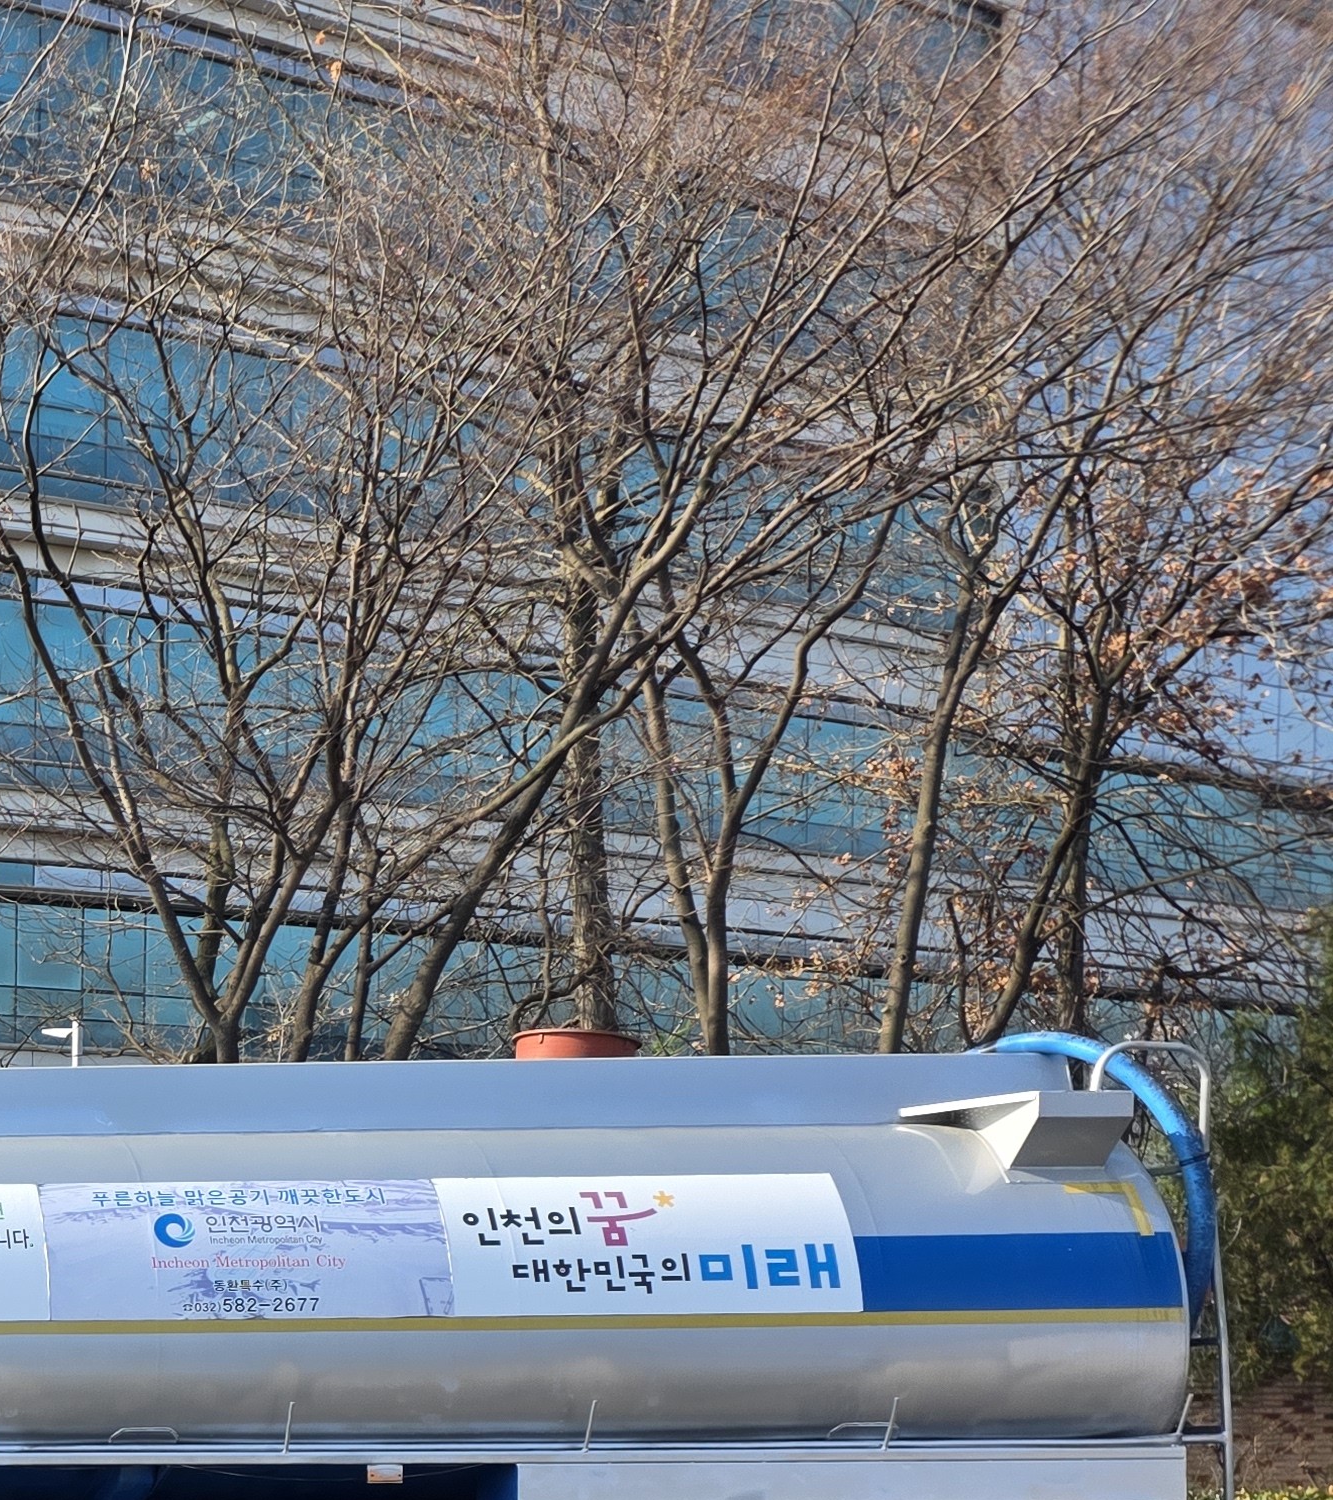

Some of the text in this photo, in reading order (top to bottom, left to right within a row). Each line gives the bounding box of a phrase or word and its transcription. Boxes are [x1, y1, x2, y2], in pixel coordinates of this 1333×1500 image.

[92, 1187, 386, 1207] 푸른하늘 맑은공기 깨끗한도시
[205, 1214, 321, 1233] 인천광역시
[462, 1191, 658, 1247] 인천의 꿈
[209, 1235, 323, 1246] Incheon Metropolitan City
[151, 1254, 347, 1270] Incheon Metropolitan City
[511, 1242, 842, 1295] 대한민국의 미래
